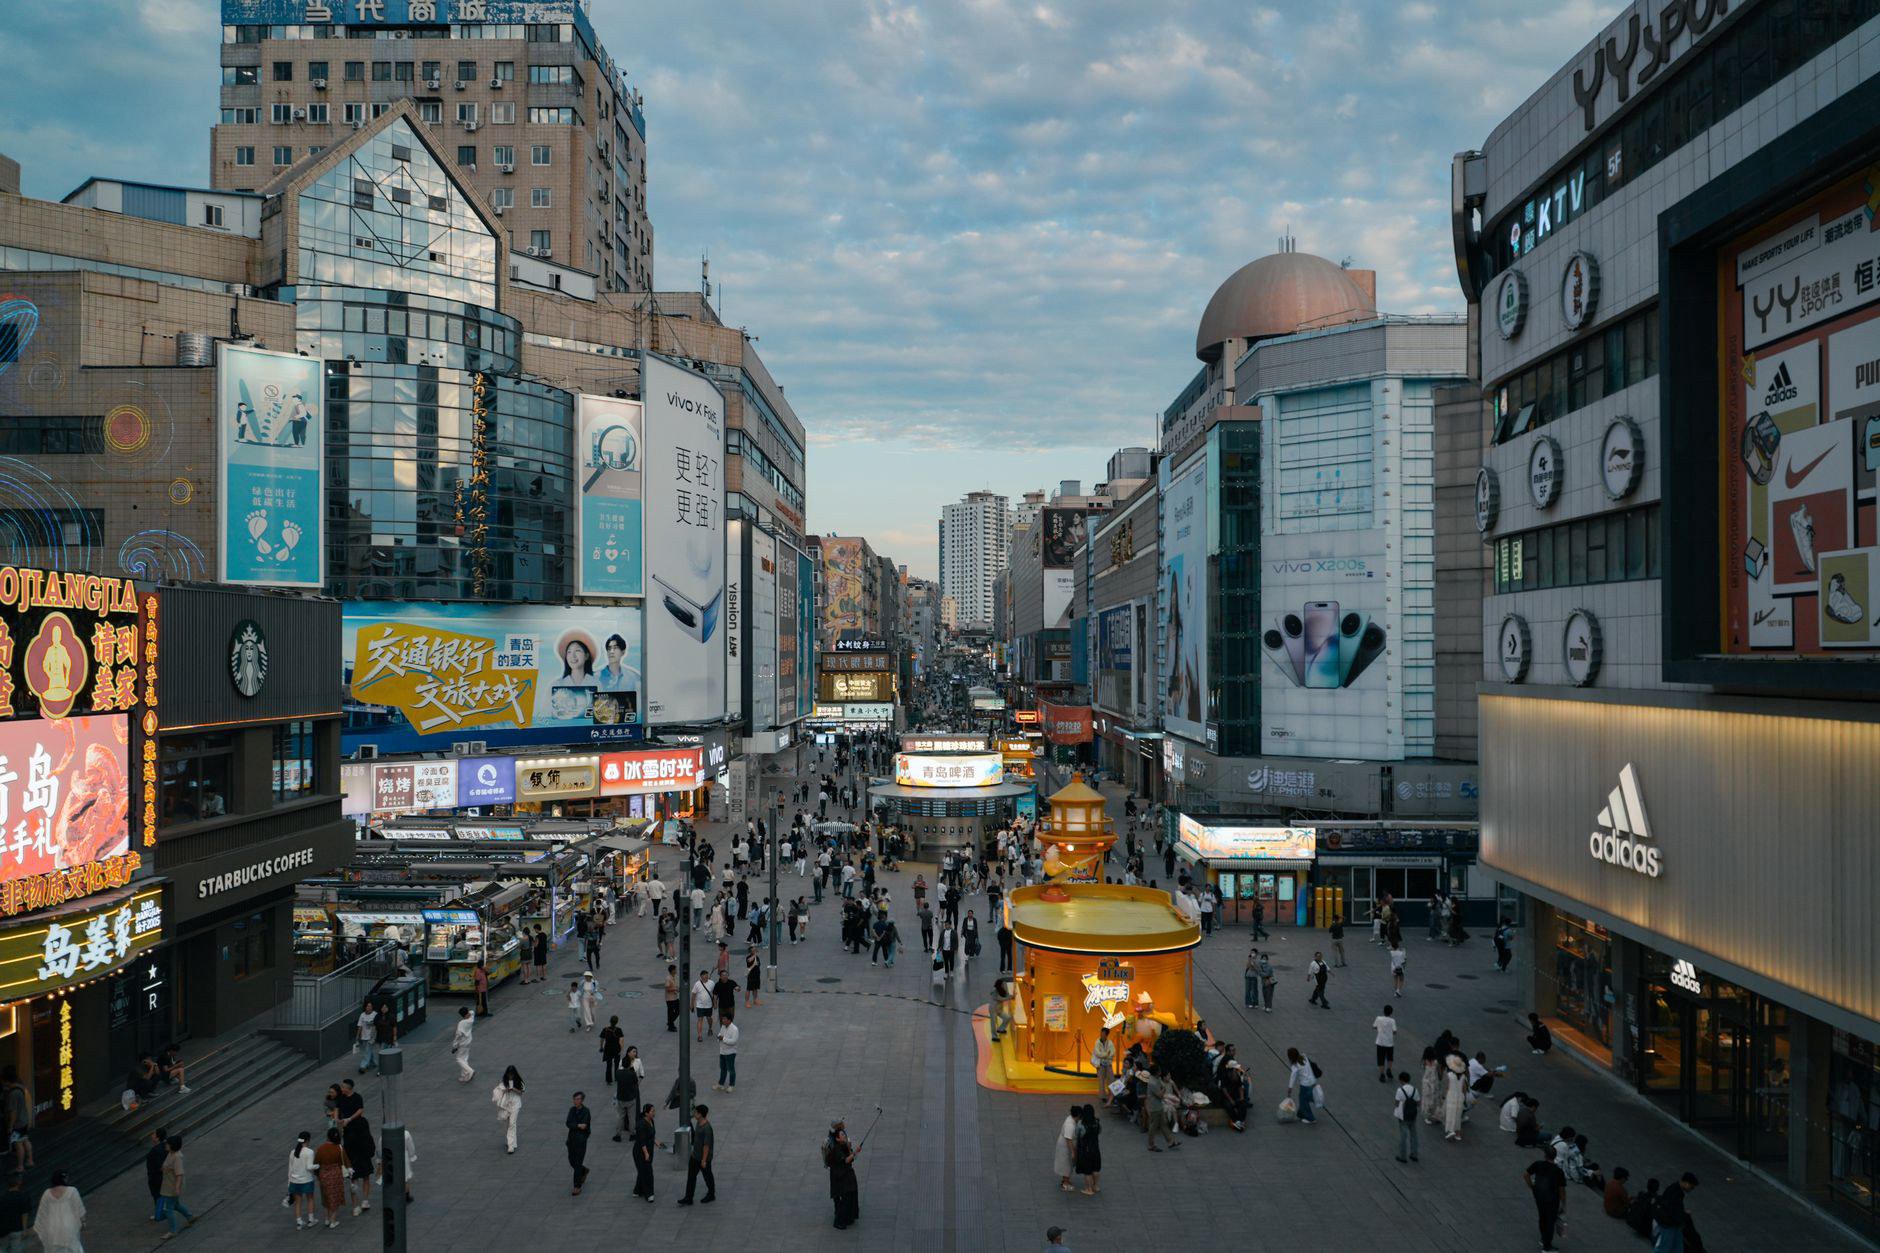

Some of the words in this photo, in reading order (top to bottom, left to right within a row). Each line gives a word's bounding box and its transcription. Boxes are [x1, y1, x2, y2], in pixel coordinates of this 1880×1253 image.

[1608, 151, 1622, 178] 5F
[1539, 171, 1584, 237] KTV
[1742, 258, 1758, 271] MAKE
[1759, 246, 1782, 265] SPORTS
[1783, 237, 1800, 254] YOUR
[1800, 227, 1815, 244] LIFE
[1854, 258, 1880, 305] 恒
[667, 392, 693, 412] vivo
[695, 402, 703, 416] X
[1765, 387, 1798, 406] adidas
[676, 446, 719, 491] 更轻了
[252, 486, 295, 498] 绿色出行
[676, 488, 719, 531] 更强了
[1273, 562, 1312, 574] vivo
[1316, 560, 1366, 572] X200s
[92, 621, 138, 667] 请到
[145, 596, 159, 707] 青岛伴手礼
[354, 627, 496, 687] 交通银行
[510, 638, 534, 652] 青岛
[498, 654, 534, 668] 的夏天
[92, 665, 139, 712] 姜家
[709, 742, 724, 766] vivo
[624, 758, 694, 780] 冰雪时光
[923, 766, 975, 779] 青岛啤酒
[1269, 771, 1315, 789] 迪信通
[379, 777, 411, 794] 烧烤
[1590, 829, 1663, 879] adidas
[1, 850, 142, 916] 非物质文化遗产
[199, 860, 273, 899] STARBUCKS
[273, 847, 314, 875] COFFEE
[38, 906, 133, 981] 岛姜家
[1671, 972, 1701, 995] adidas
[149, 992, 158, 1011] R
